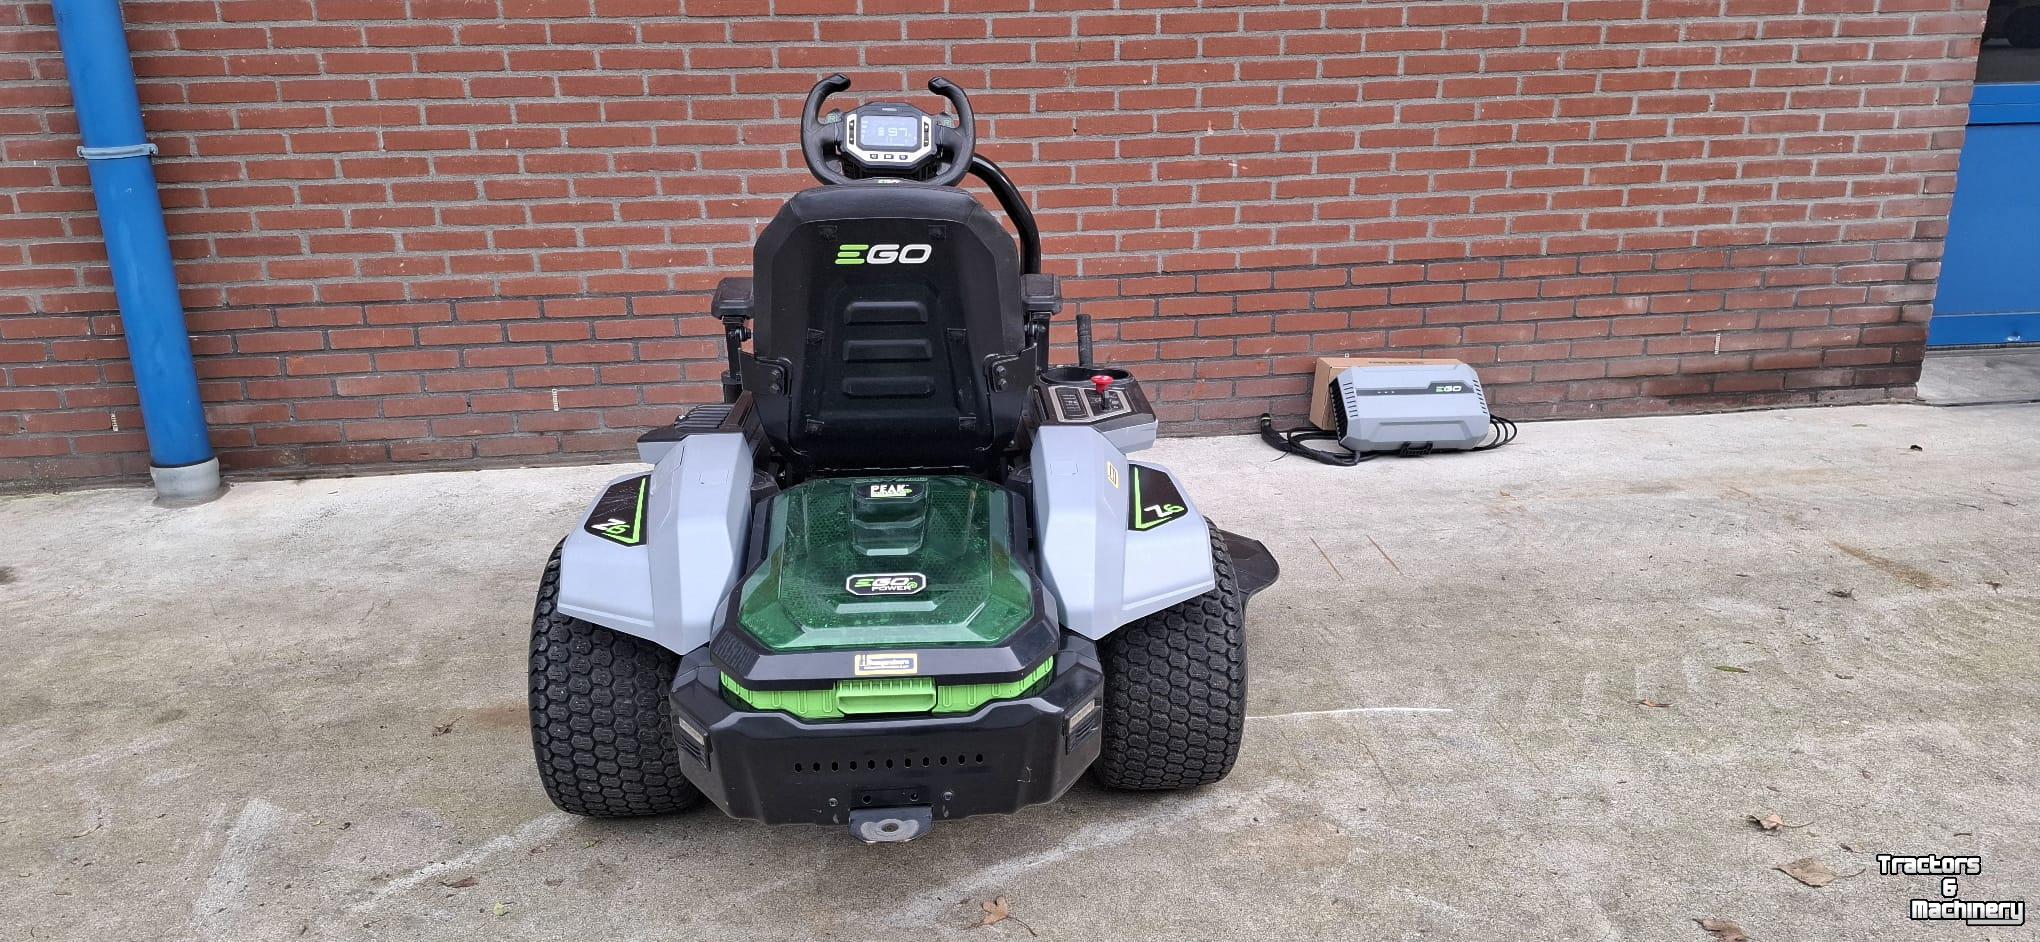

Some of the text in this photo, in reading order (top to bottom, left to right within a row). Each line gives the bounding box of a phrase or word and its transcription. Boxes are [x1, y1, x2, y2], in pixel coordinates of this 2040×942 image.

[835, 244, 932, 265] EGO
[1435, 385, 1462, 393] EGO
[870, 484, 906, 493] PEAK
[1144, 504, 1184, 518] Z6
[590, 518, 630, 534] Z6
[854, 578, 910, 588] EGO
